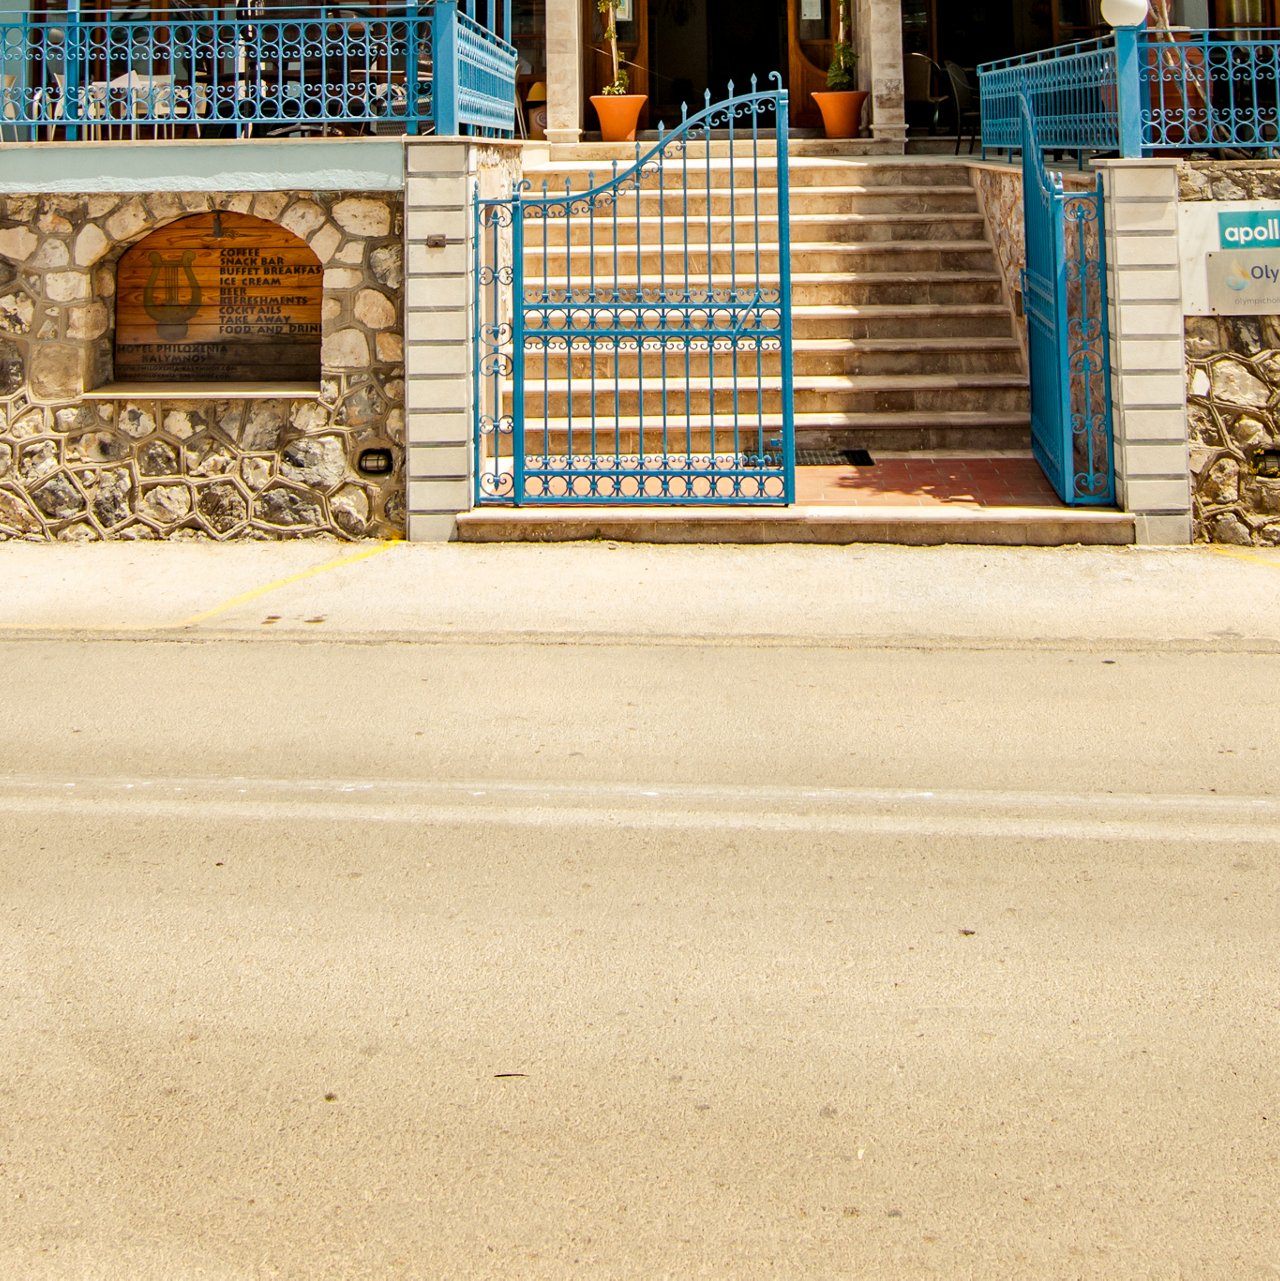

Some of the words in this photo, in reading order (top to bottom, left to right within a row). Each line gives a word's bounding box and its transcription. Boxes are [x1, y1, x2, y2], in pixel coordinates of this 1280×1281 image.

[220, 248, 260, 257] COFFEE
[220, 257, 257, 266] SNACK
[261, 256, 284, 265] BAR
[219, 267, 260, 276] BUFFET
[263, 265, 322, 275] BREAKFAS
[220, 277, 236, 286] ICE
[242, 277, 281, 286] CREAM
[220, 287, 247, 296] BEER
[219, 296, 308, 305] REFRESHMENTS
[219, 315, 249, 324] TAKE
[255, 315, 291, 323] AWAY
[219, 325, 252, 334] FOOD
[257, 325, 283, 334] AND
[118, 344, 153, 353] HOTEL
[157, 344, 228, 353] PHILOXENIA
[142, 354, 207, 363] KALYMNOS
